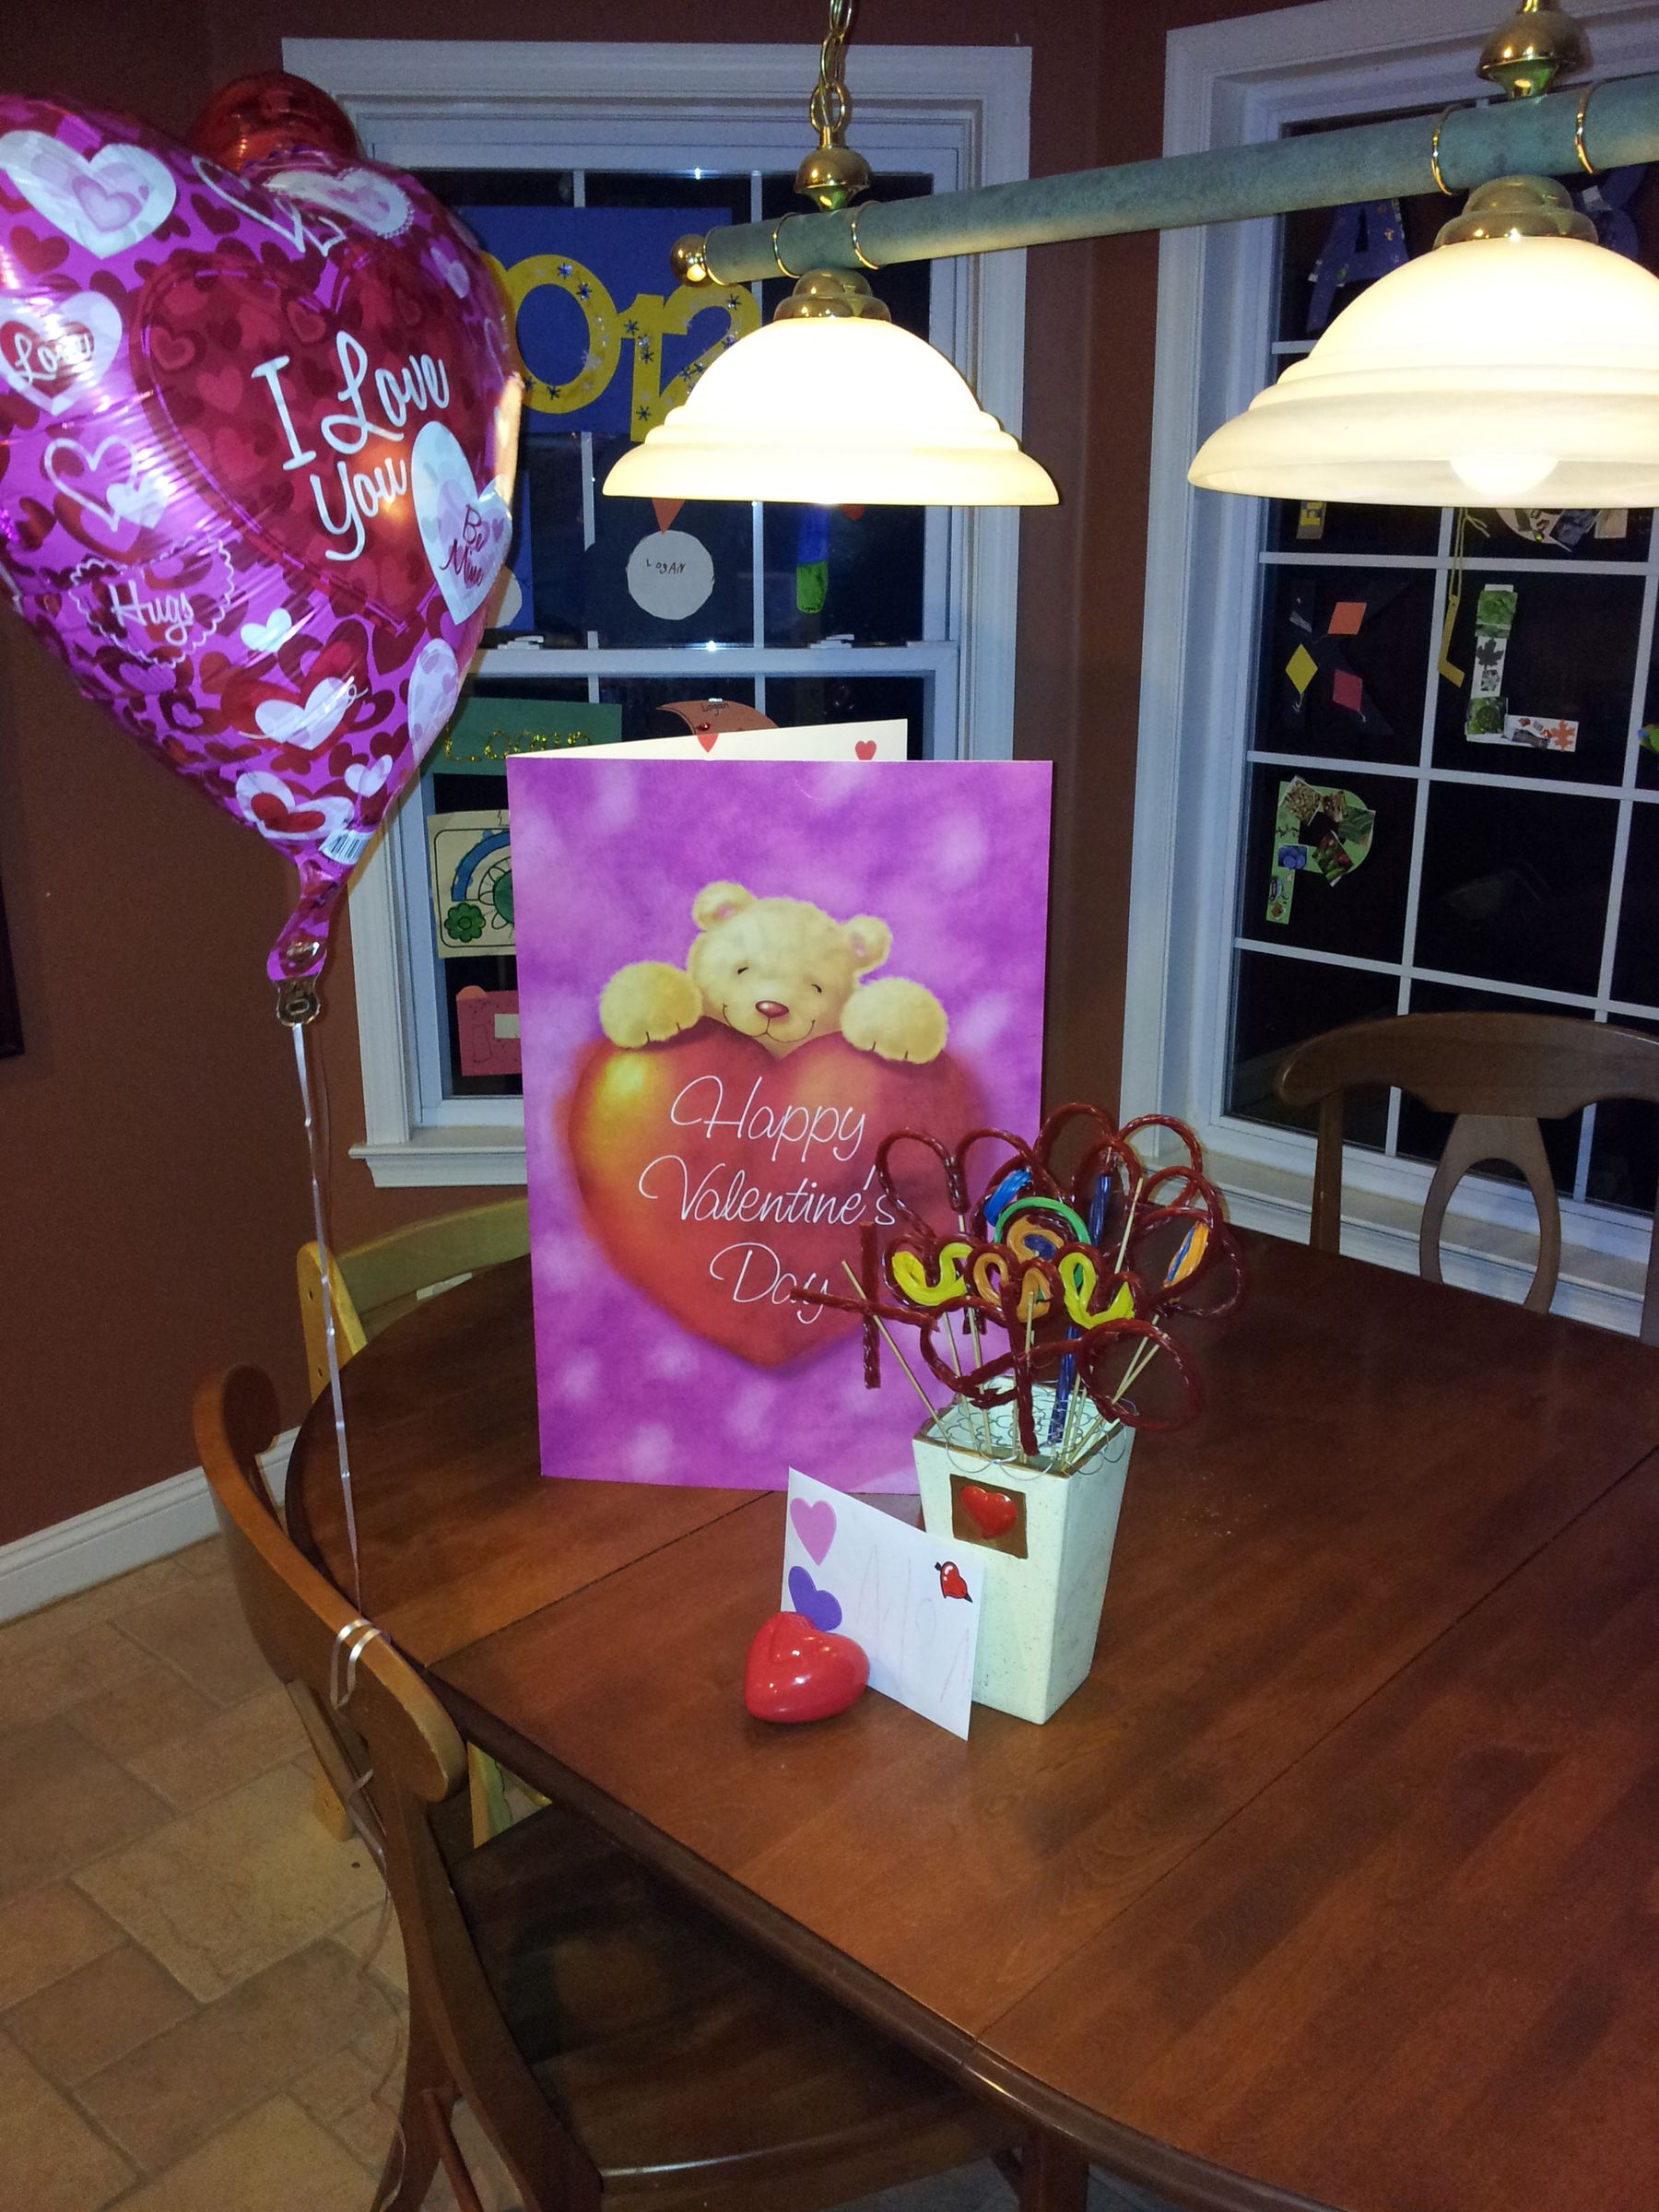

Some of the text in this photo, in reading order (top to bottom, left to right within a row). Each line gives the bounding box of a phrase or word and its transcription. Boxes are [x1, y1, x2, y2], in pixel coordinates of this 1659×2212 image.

[252, 330, 451, 470] I Love
[439, 538, 485, 589] Mine
[463, 503, 488, 552] Be
[109, 579, 194, 645] Hugs
[670, 1075, 866, 1162] Happy
[639, 1155, 897, 1227] Valentine's
[709, 1241, 830, 1324] Day
